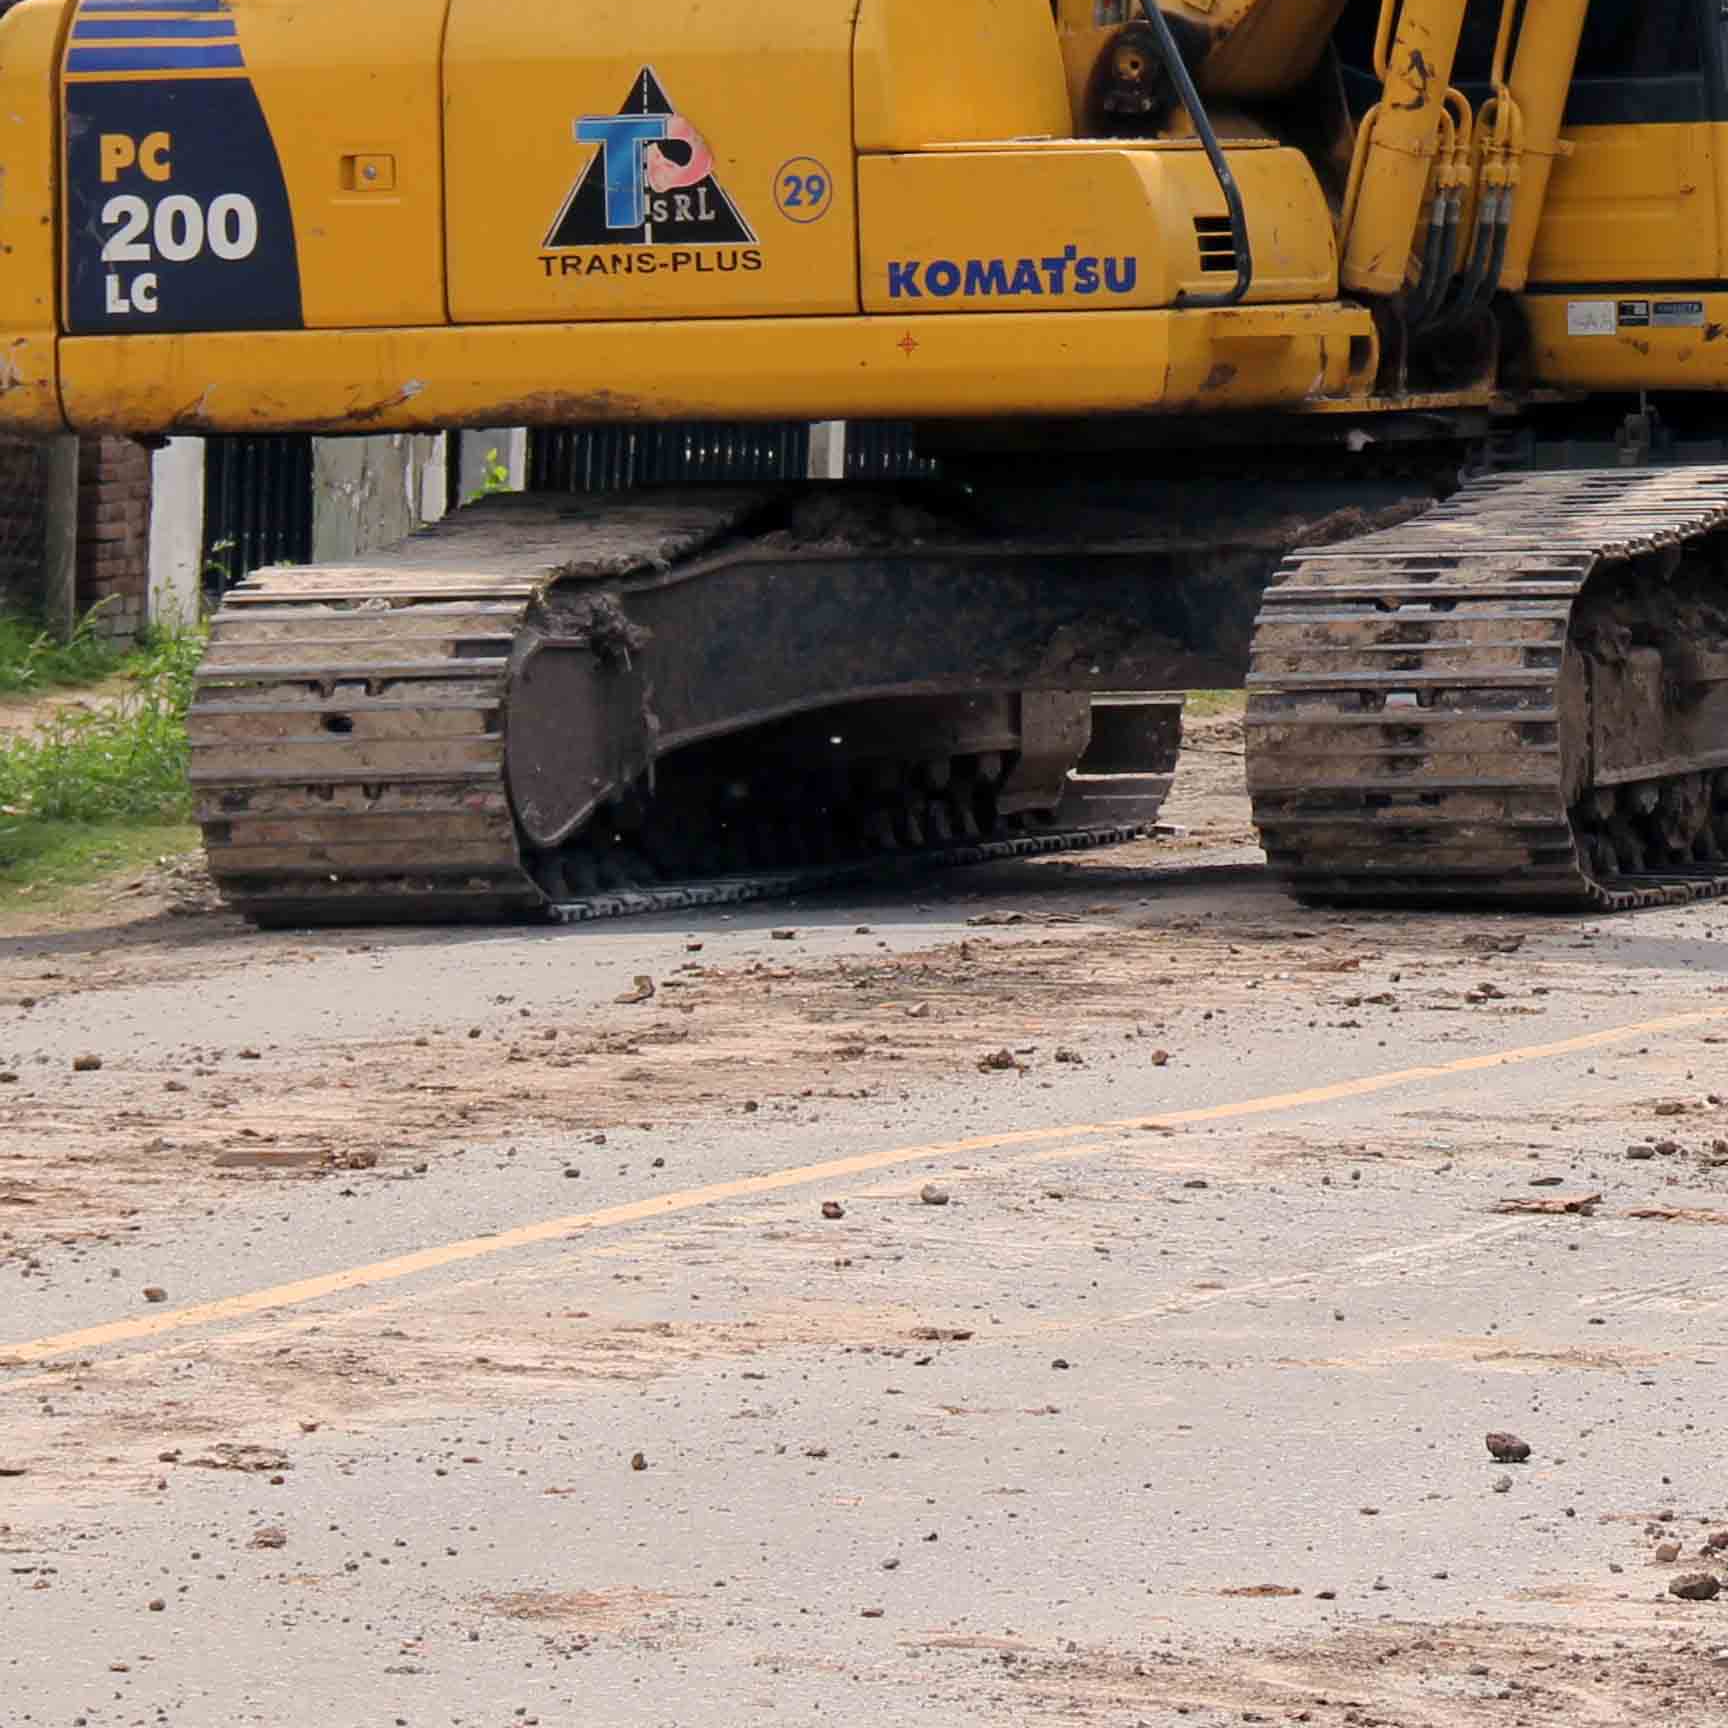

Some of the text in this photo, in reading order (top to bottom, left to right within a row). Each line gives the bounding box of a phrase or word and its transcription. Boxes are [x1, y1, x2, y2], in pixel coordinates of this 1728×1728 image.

[100, 132, 172, 182] PC
[783, 174, 825, 207] 29
[101, 193, 258, 261] 200
[537, 249, 762, 277] TRANS-PLUS
[888, 245, 1137, 298] KOMATSU
[105, 273, 158, 314] LC
